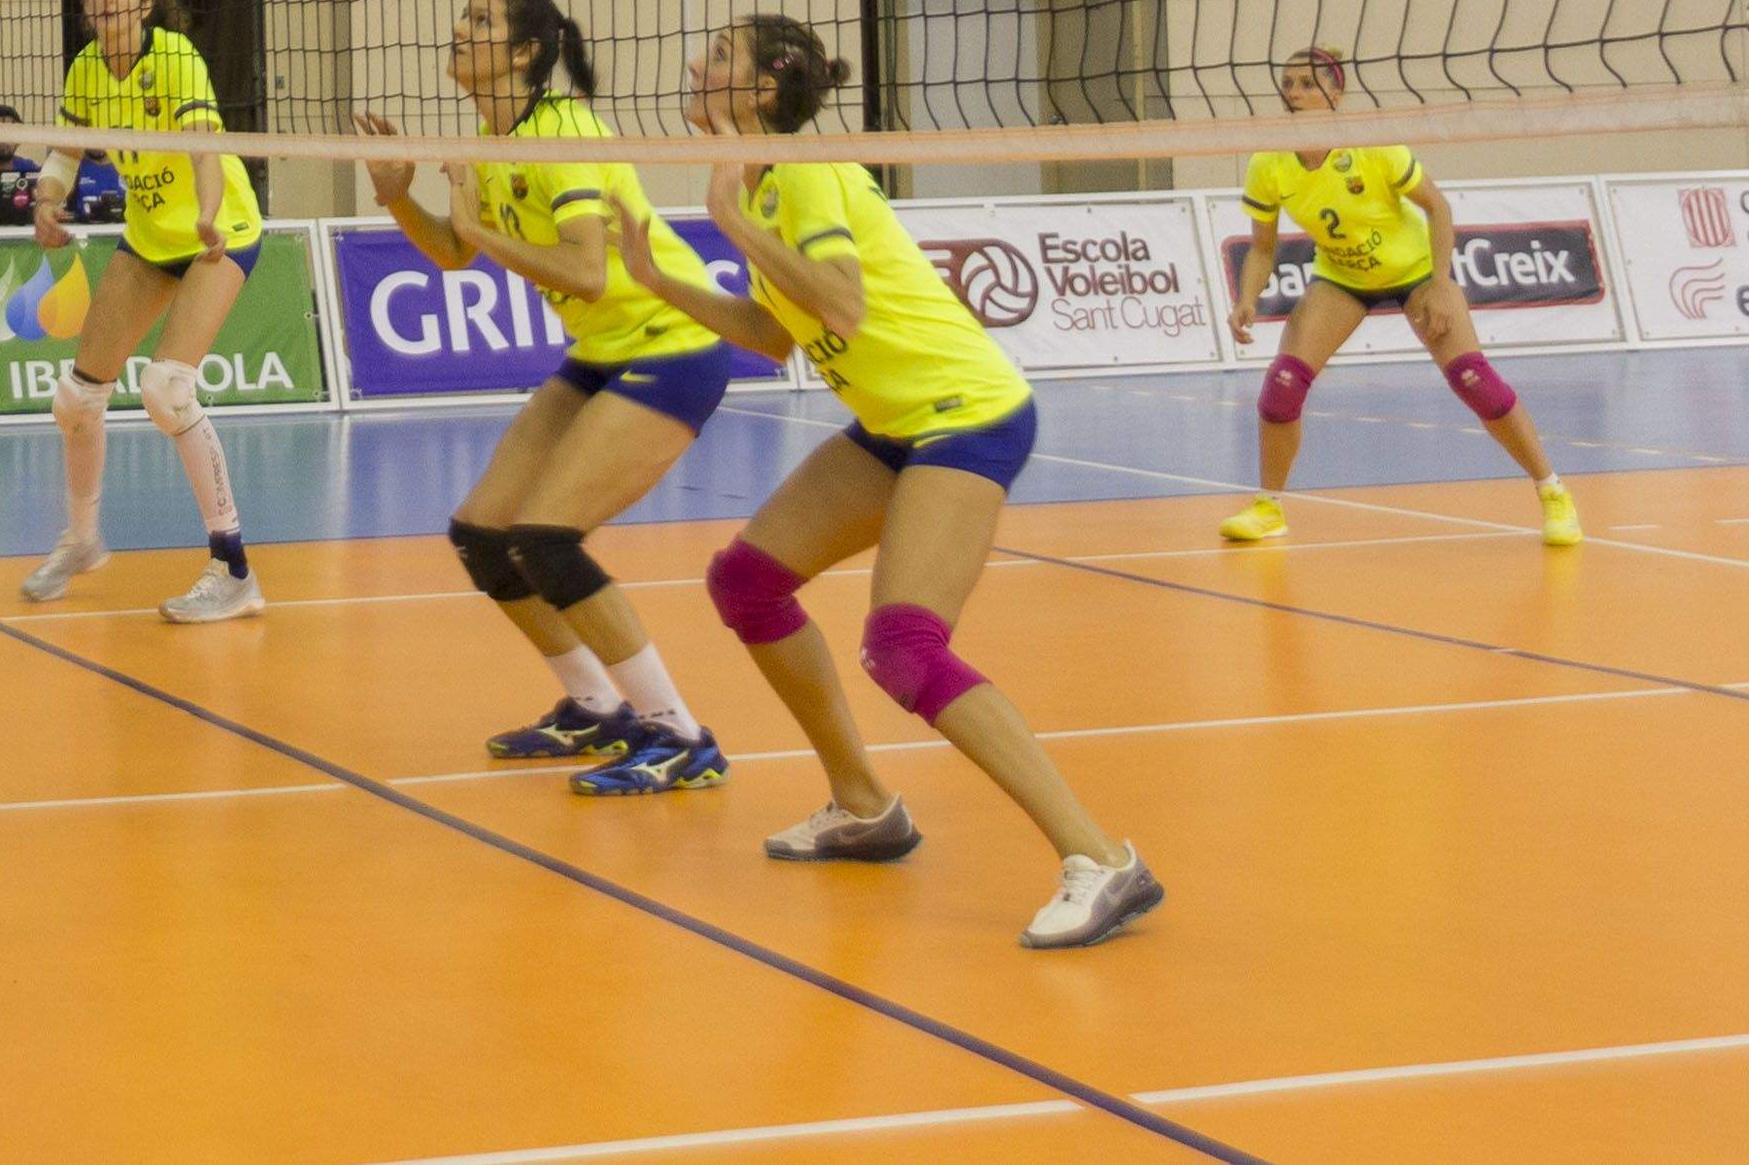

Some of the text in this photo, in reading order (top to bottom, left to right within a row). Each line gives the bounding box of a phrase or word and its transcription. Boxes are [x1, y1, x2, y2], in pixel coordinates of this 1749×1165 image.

[1320, 208, 1346, 239] 2
[1038, 231, 1150, 264] Escola
[1045, 263, 1180, 296] Voleibol
[1052, 296, 1206, 338] Sant Cugat
